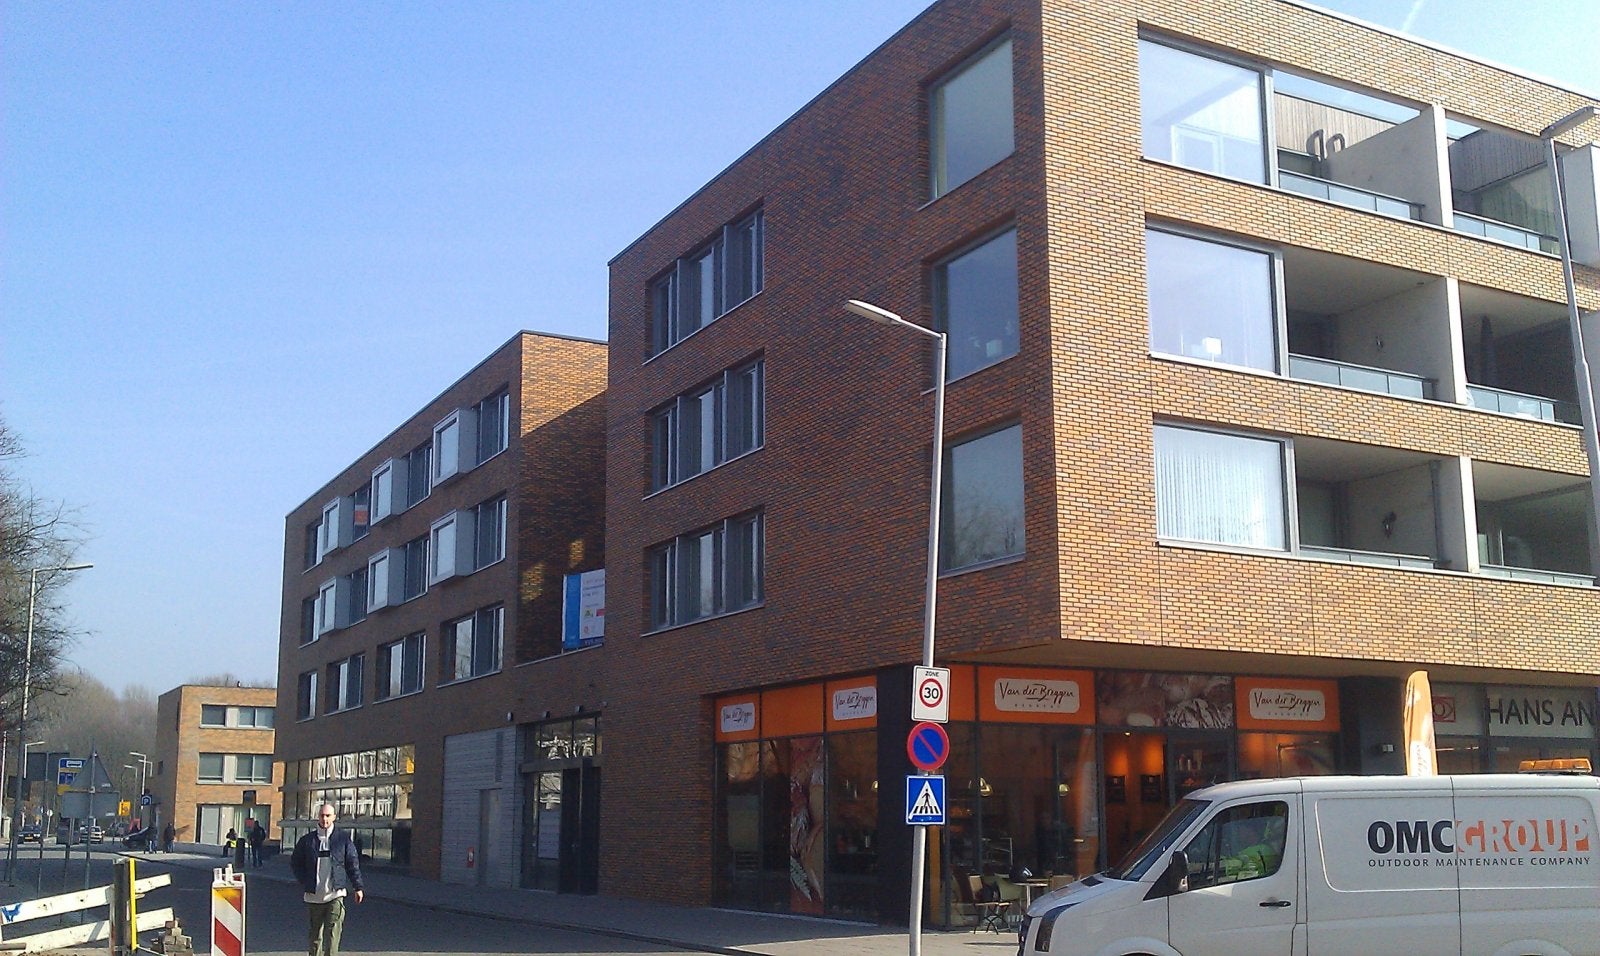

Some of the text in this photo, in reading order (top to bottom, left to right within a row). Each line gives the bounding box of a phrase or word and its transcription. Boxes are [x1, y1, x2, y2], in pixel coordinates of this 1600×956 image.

[925, 670, 940, 678] ZONE
[923, 687, 940, 700] 30
[999, 682, 1020, 700] Van
[1253, 691, 1273, 708] Van
[1488, 698, 1554, 726] HANS
[1368, 856, 1591, 868] OUTDOOR MAINTENANCE COMPANY
